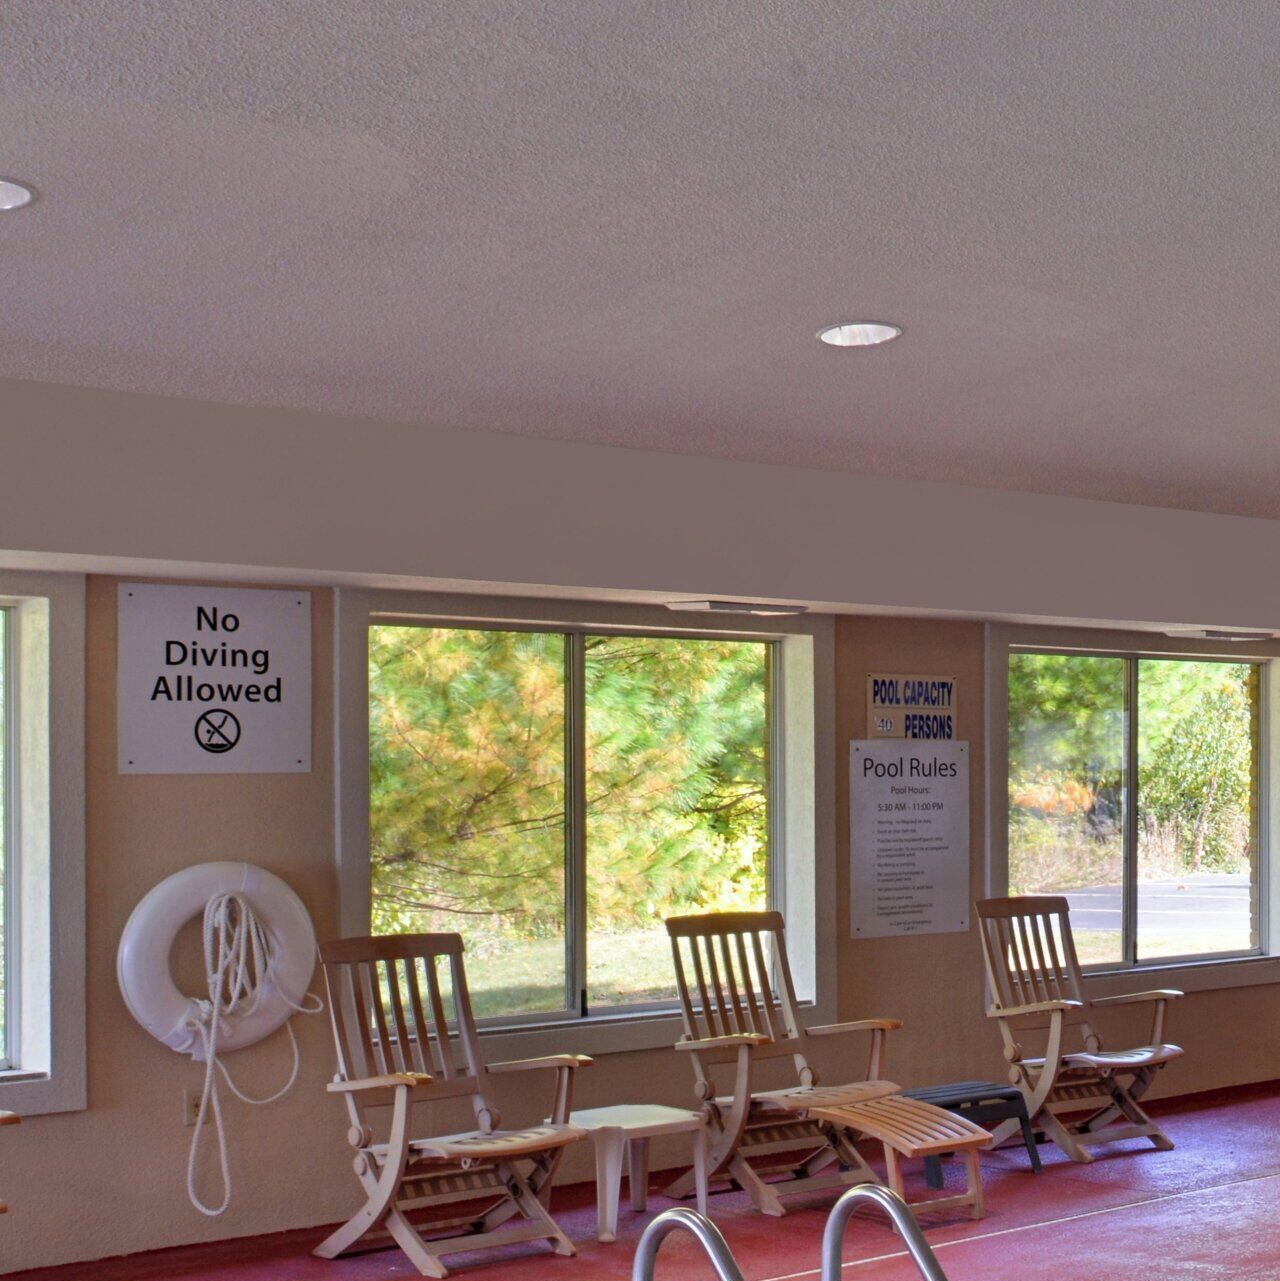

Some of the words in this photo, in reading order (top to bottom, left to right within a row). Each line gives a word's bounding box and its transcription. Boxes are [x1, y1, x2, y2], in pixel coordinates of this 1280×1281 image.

[197, 606, 240, 632] No
[165, 640, 269, 674] Diving
[151, 675, 282, 703] Allowed
[873, 679, 900, 705] POOL
[903, 680, 953, 706] CAPACITY
[904, 714, 953, 739] PERSONS
[863, 756, 903, 778] Pool
[910, 756, 957, 778] Rules
[890, 786, 907, 795] Pool
[894, 803, 906, 811] AM
[932, 802, 944, 811] PM
